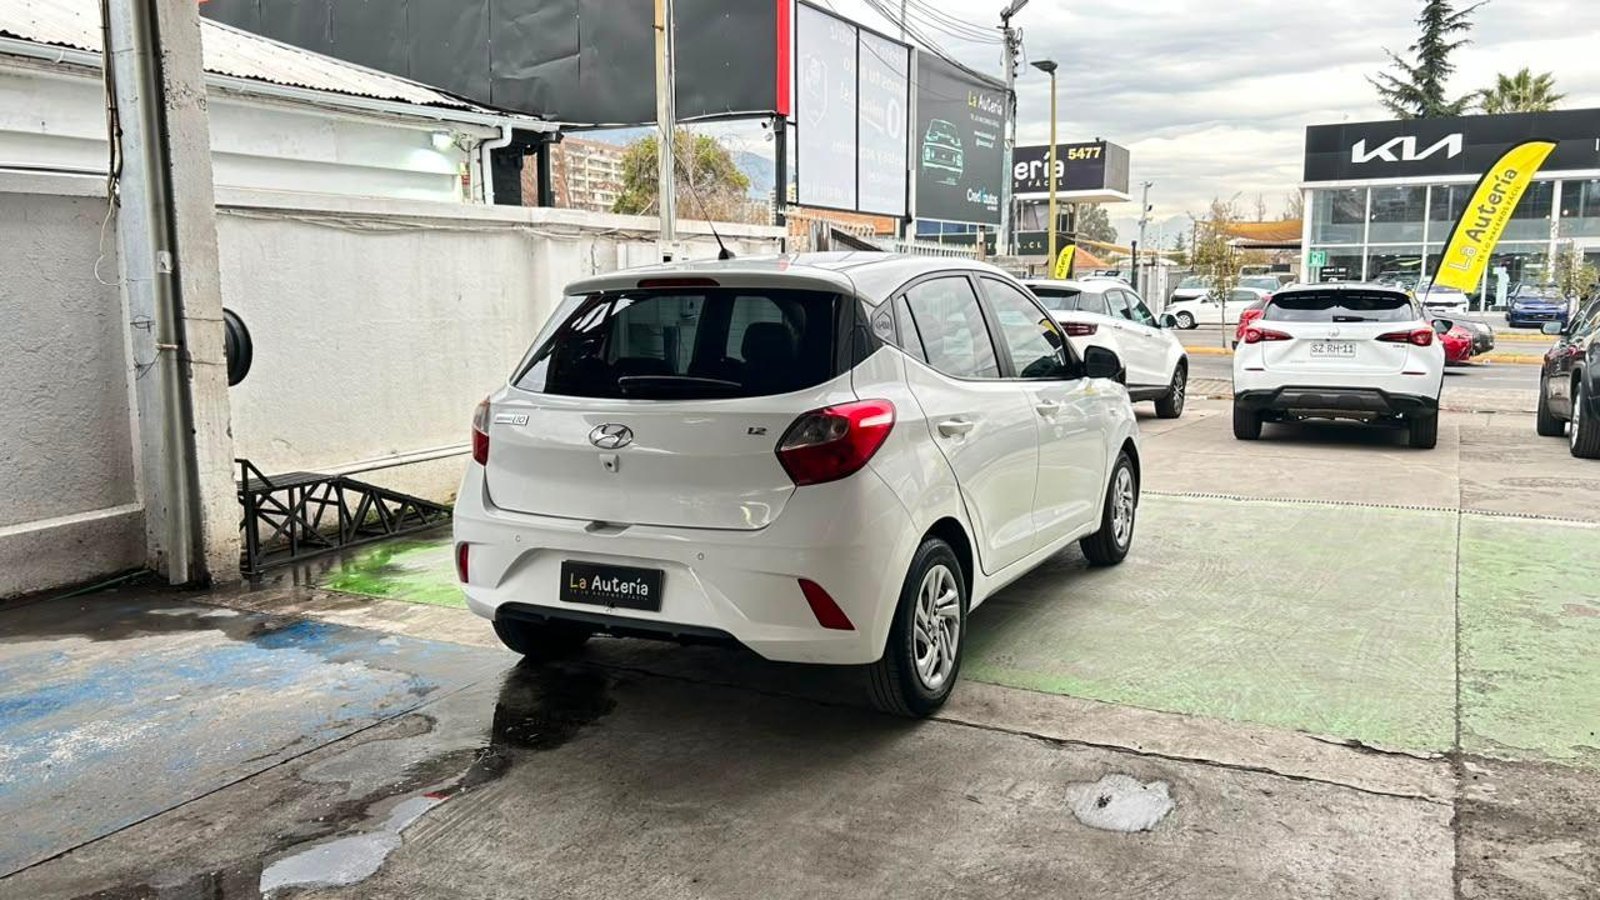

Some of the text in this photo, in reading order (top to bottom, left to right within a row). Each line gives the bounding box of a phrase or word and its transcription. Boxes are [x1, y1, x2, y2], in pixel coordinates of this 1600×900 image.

[1068, 147, 1101, 160] 5477
[1351, 133, 1463, 163] KIA
[1028, 179, 1063, 188] FÁCL
[1449, 168, 1518, 270] La Autería
[570, 572, 587, 589] La
[591, 574, 648, 596] Autería
